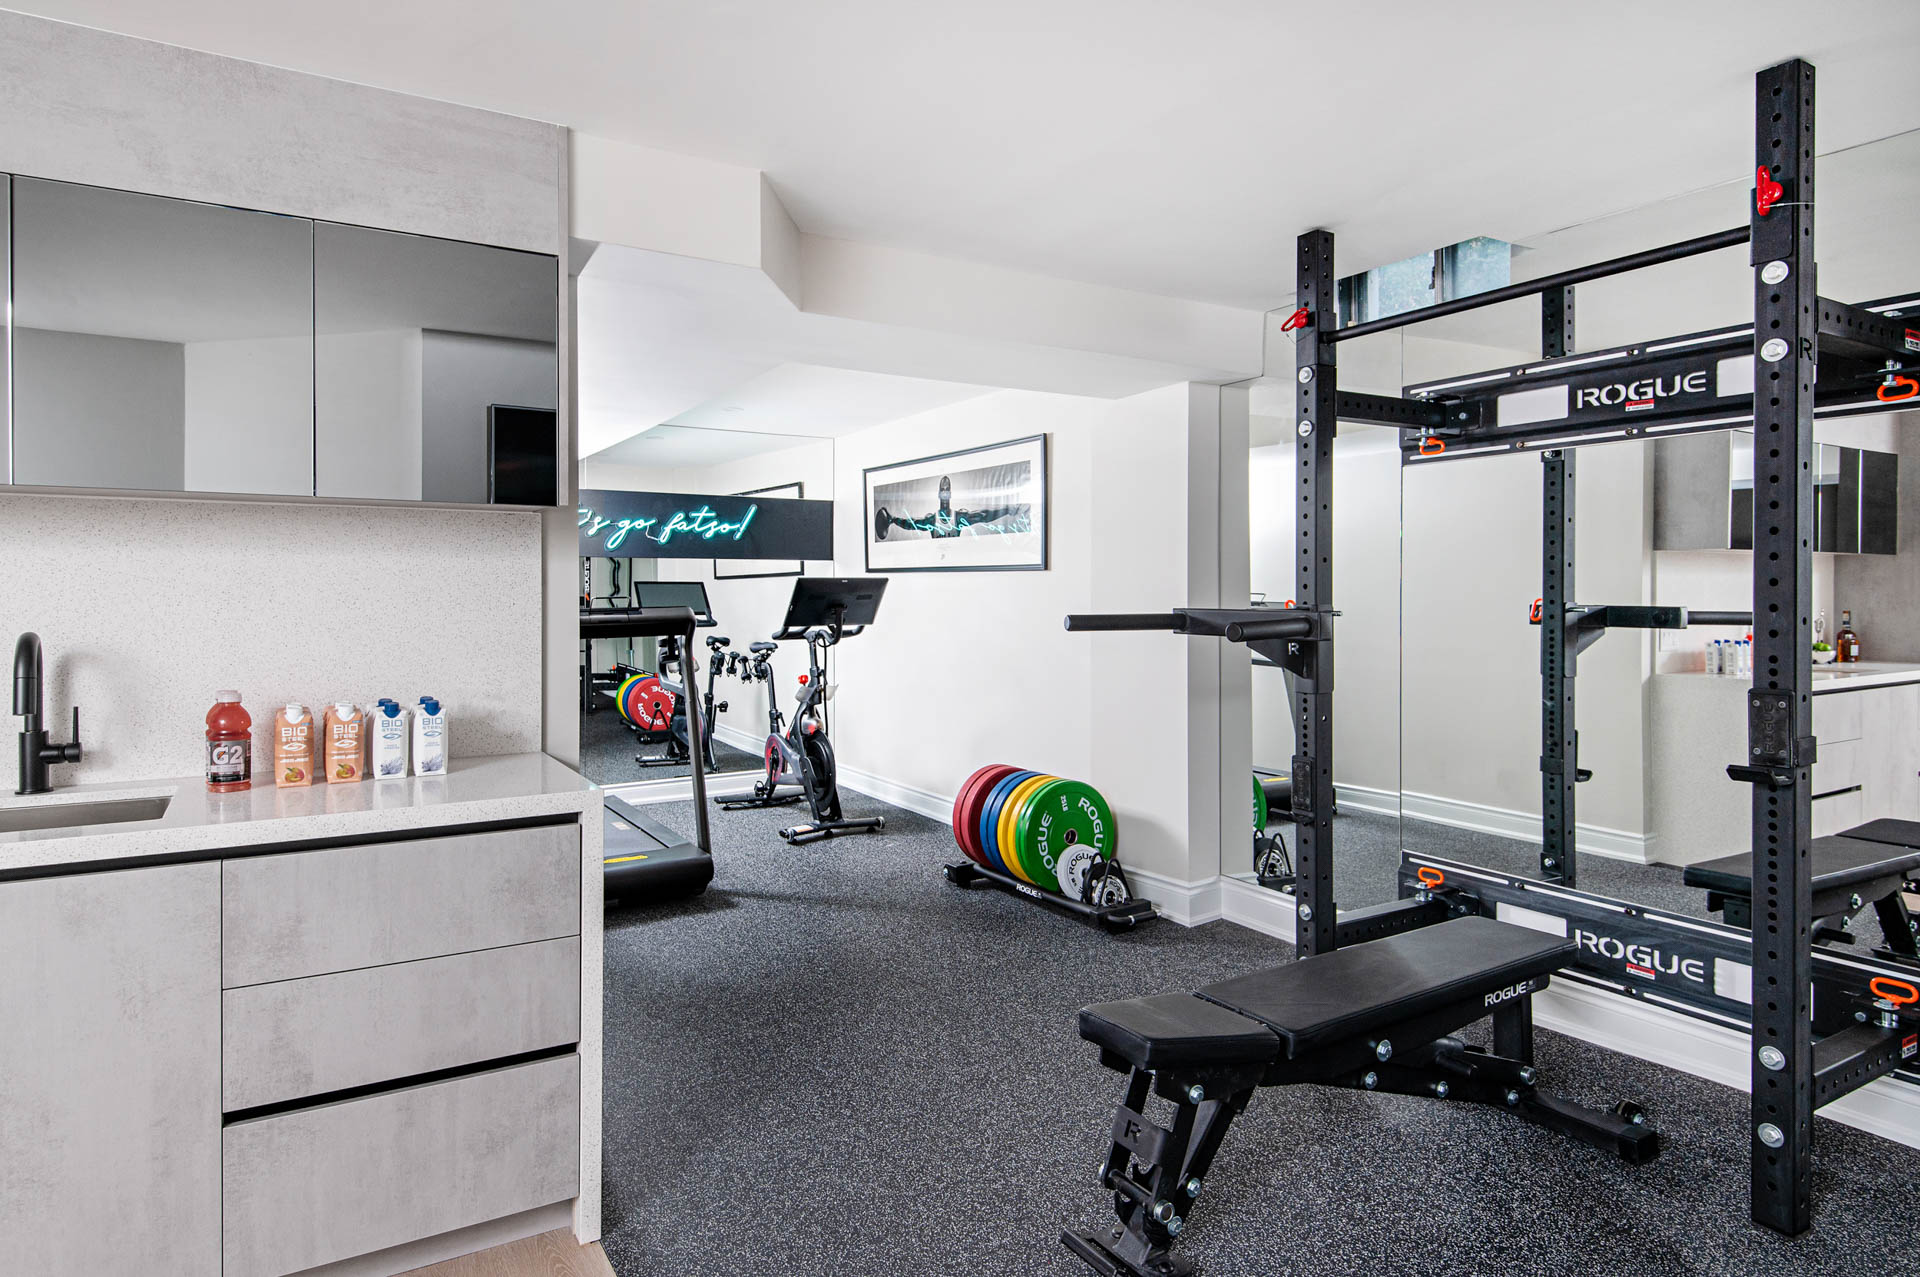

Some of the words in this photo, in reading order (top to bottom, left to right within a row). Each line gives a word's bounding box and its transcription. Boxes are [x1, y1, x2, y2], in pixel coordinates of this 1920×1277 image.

[1576, 370, 1707, 409] ROGUE
[604, 518, 657, 551] go
[657, 504, 758, 545] fatso!
[281, 726, 308, 737] BIO
[333, 723, 359, 734] BIO
[381, 719, 403, 728] BIO
[422, 717, 443, 726] BIO
[212, 745, 243, 765] G2
[1078, 797, 1104, 848] ROGU
[1016, 883, 1038, 898] ROGUE
[1574, 928, 1705, 984] ROGUE
[1484, 981, 1527, 1007] ROGUE
